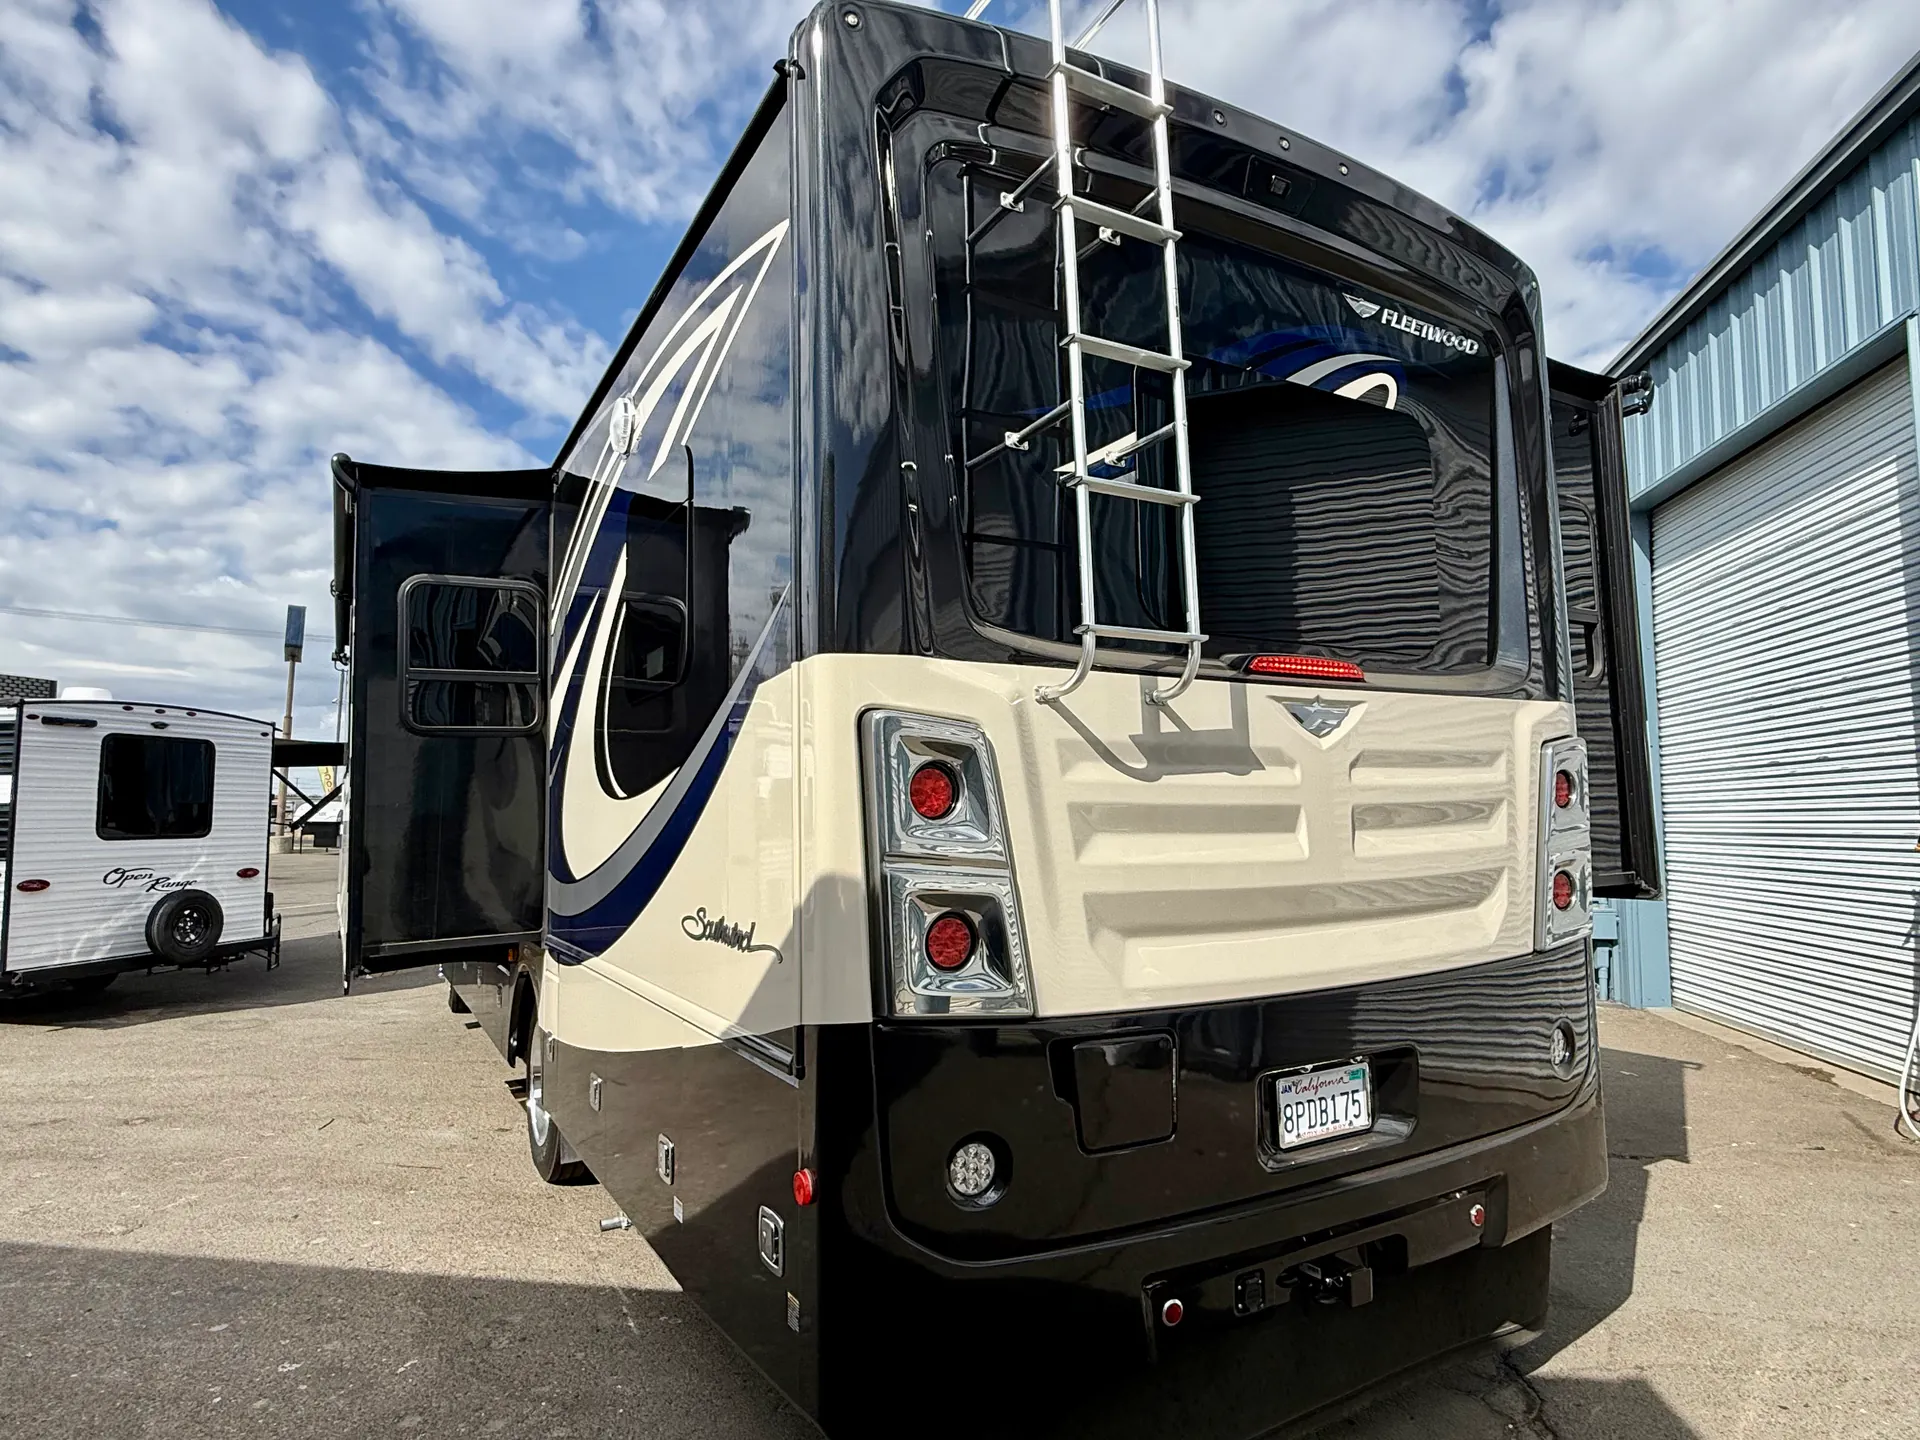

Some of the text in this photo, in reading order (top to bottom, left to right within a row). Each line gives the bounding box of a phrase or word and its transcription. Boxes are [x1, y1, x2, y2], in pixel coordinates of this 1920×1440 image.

[1381, 308, 1480, 355] FLEETWOOD
[103, 867, 155, 888] Open
[140, 877, 197, 892] Range
[1281, 1084, 1293, 1095] JAN
[1293, 1076, 1350, 1095] California
[1283, 1089, 1362, 1134] 8PDB175
